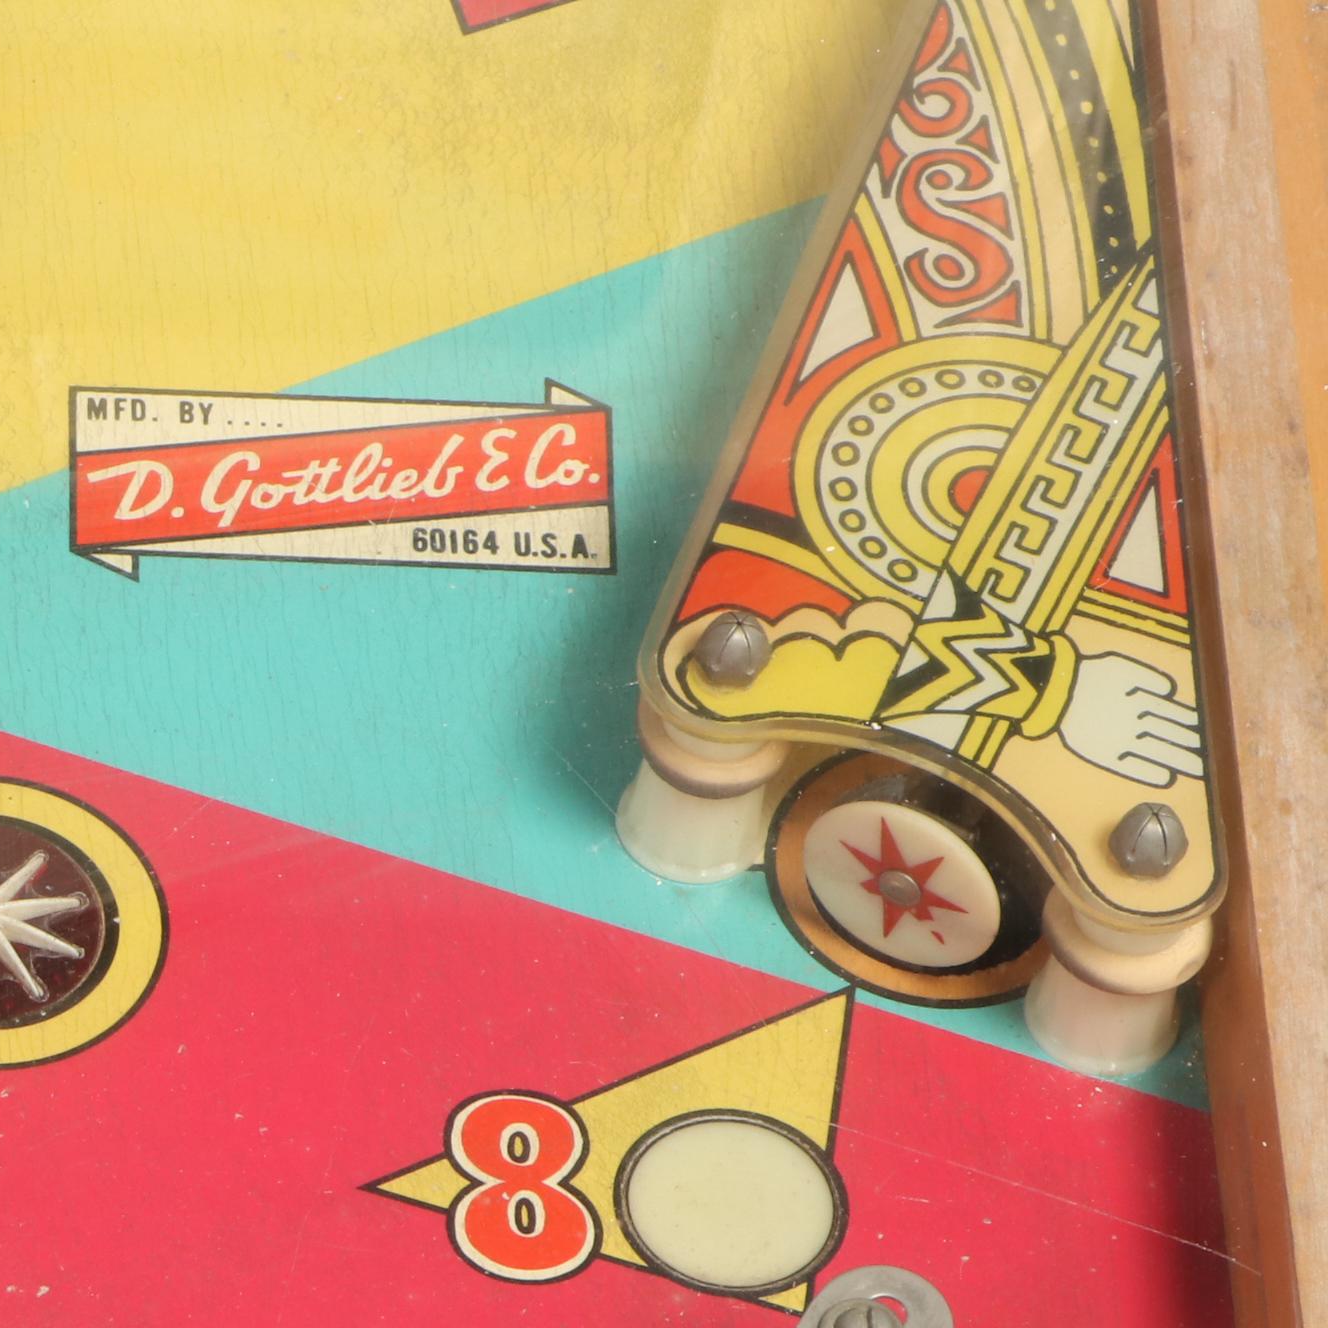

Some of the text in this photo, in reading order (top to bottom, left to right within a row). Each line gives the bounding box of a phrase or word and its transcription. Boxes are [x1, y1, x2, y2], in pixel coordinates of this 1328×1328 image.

[87, 398, 159, 424] MFD.
[86, 460, 185, 521] D.
[200, 434, 465, 529] Gottlieb
[524, 423, 601, 489] Co.
[411, 527, 597, 560] 60164 U.S.A.
[444, 1088, 603, 1284] 8
